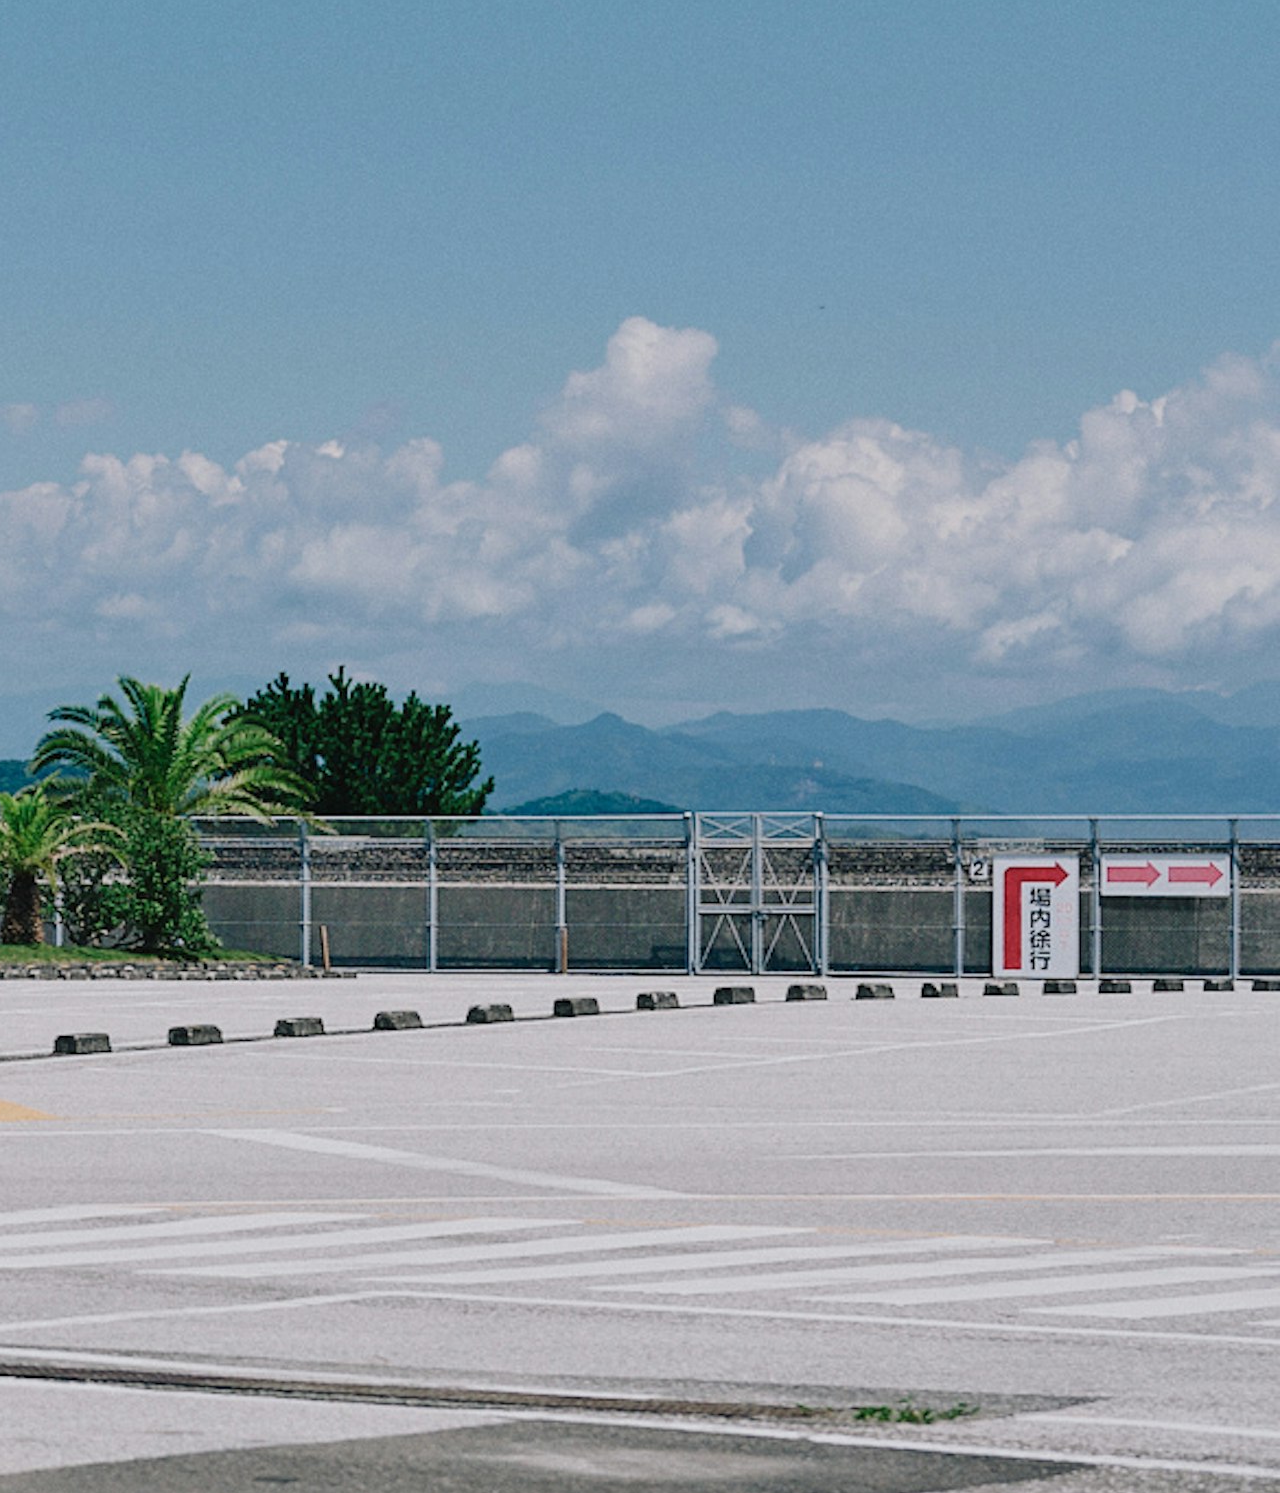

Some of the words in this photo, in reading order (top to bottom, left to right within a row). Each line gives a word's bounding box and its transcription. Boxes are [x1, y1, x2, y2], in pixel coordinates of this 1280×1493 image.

[973, 861, 984, 876] 2
[1029, 887, 1052, 971] 場内徐行
